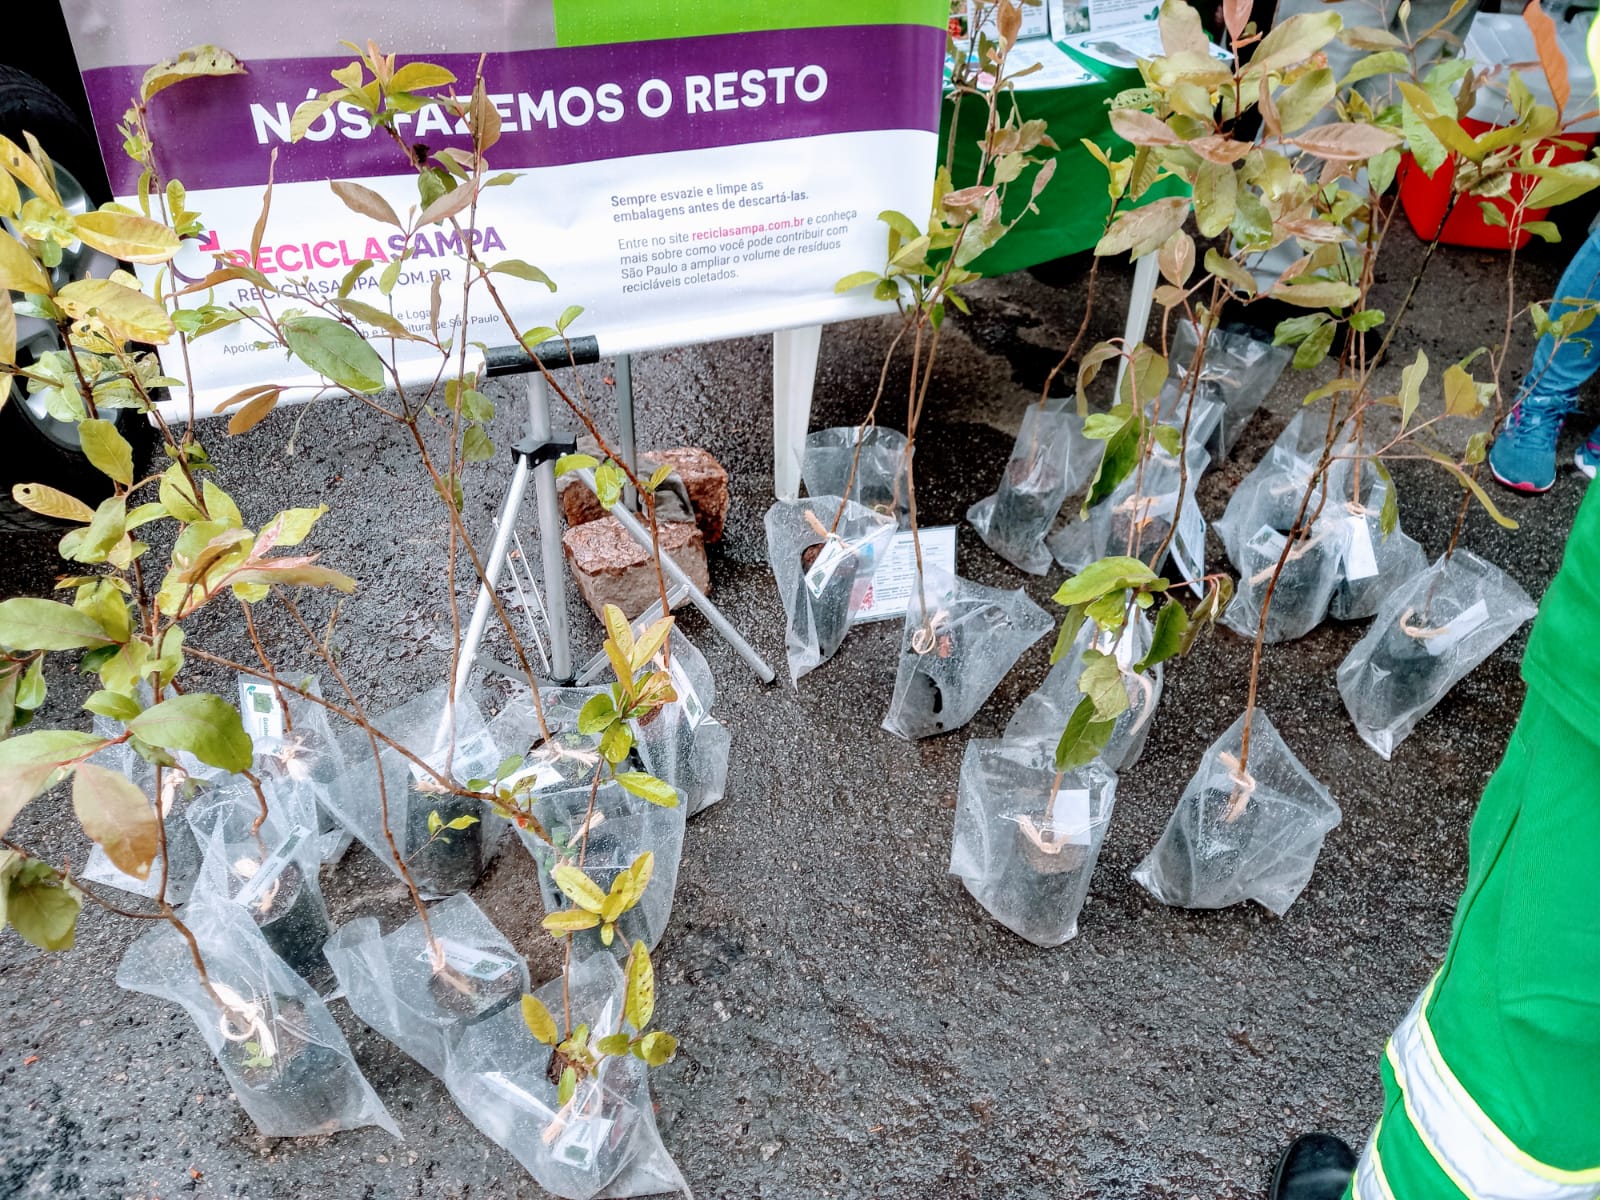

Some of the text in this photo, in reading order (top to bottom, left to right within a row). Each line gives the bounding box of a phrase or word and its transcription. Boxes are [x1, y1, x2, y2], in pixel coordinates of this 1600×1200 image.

[250, 88, 372, 144] NÓS
[637, 78, 673, 119] O
[685, 64, 828, 114] RESTO
[611, 181, 764, 207] Sempre esvazie e limpe as
[613, 190, 809, 222] embalagens antes de descartá-las.
[618, 209, 857, 250] Entre no site reciclasampa.com.br e conheça
[620, 225, 848, 265] mais sobre como você pode contribuir com
[229, 226, 506, 274] RECICLASAMPA
[621, 240, 841, 280] São Paulo a ampliar o volume de resíduos
[237, 268, 451, 302] RECICLASAPAOM.BR
[622, 269, 740, 294] recicláveis coletados.
[471, 314, 499, 324] Paulo
[223, 342, 255, 356] Apoio
